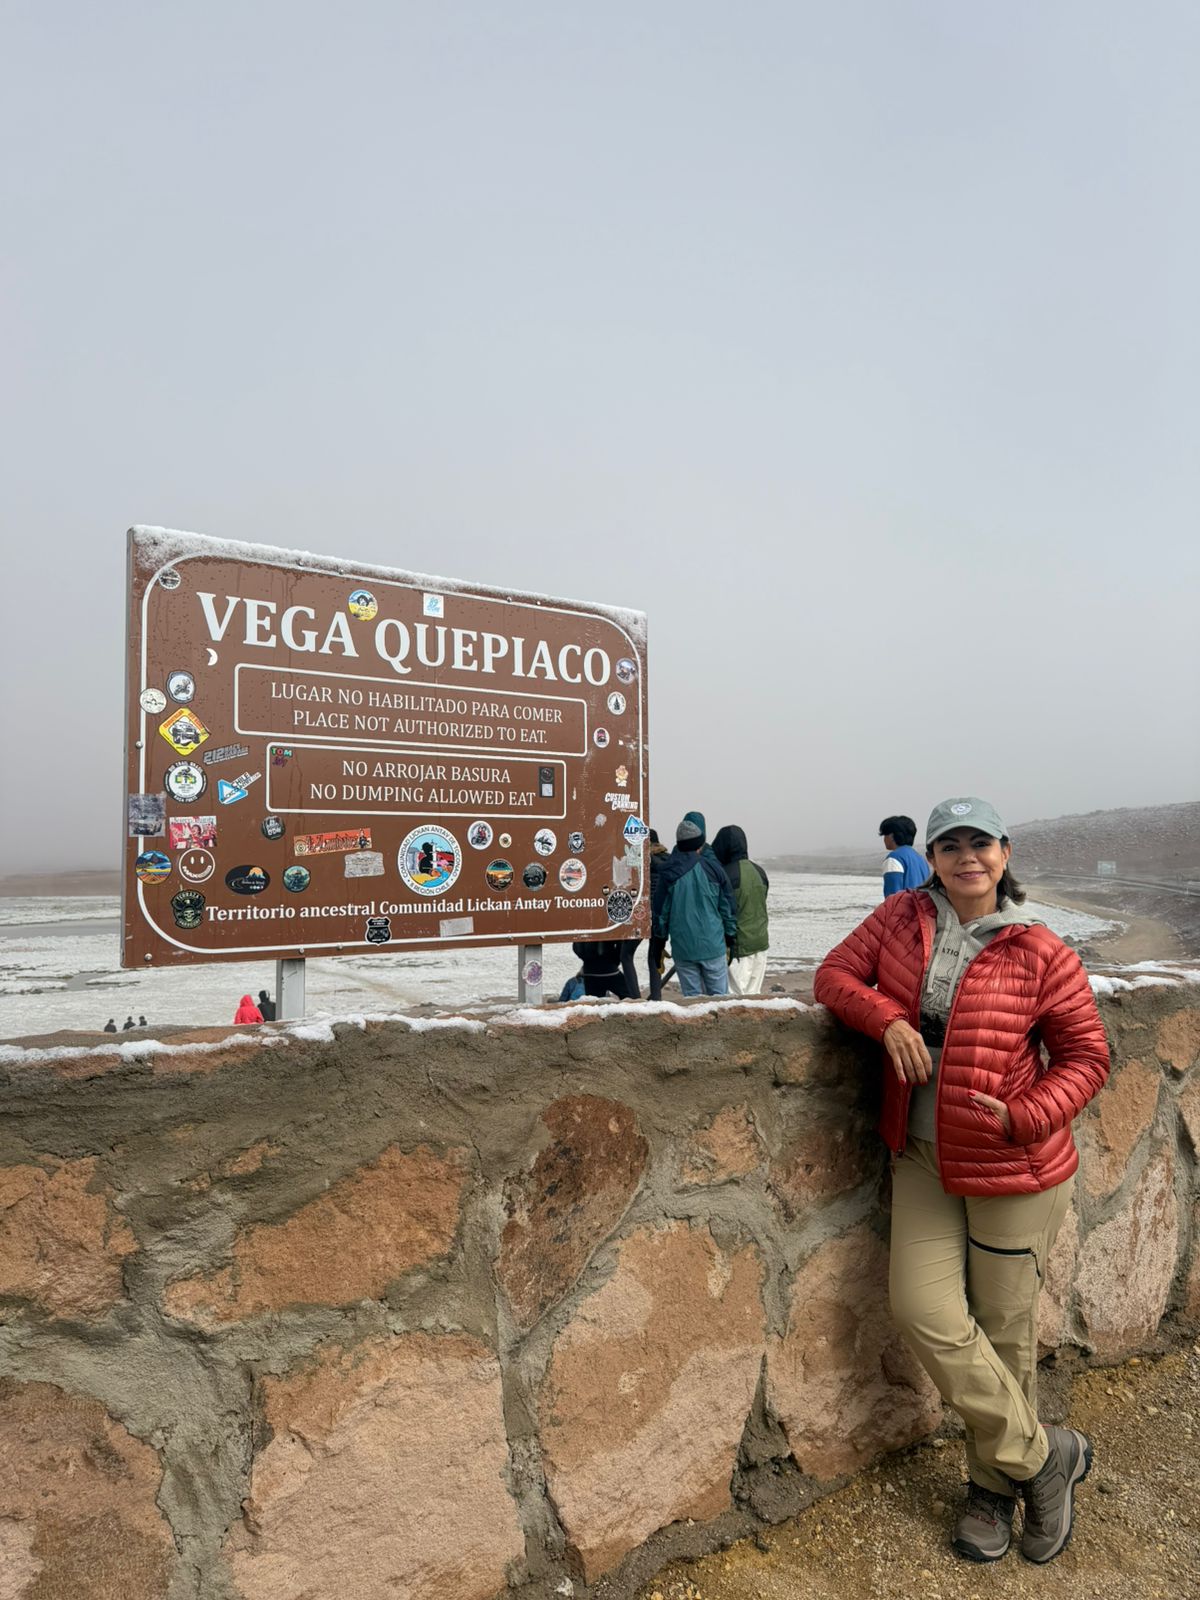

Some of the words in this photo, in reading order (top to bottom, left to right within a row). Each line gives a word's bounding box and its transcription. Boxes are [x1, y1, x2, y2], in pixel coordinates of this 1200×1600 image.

[196, 592, 359, 657] VEGA
[375, 619, 611, 686] QUEPIACO
[271, 682, 333, 703] LUGAR
[338, 688, 363, 706] NO
[368, 691, 468, 715] HABILITADO
[472, 701, 510, 718] PARA
[513, 705, 563, 723] COMER
[293, 709, 349, 729] PLACE
[354, 715, 390, 732] NOT
[394, 718, 494, 740] AUTHORIZED
[497, 726, 517, 741] TO
[520, 728, 548, 744] EAT.
[271, 747, 293, 757] TOM
[342, 760, 368, 777] NO
[372, 762, 447, 783] ARROJAR
[451, 766, 511, 783] BASURA
[310, 783, 337, 800] NO
[342, 784, 423, 803] DUMPING
[428, 788, 504, 805] ALLOWED
[509, 791, 536, 806] EAT
[431, 826, 450, 838] ANTAY
[624, 826, 648, 835] ALPES
[206, 904, 296, 921] Territorio
[300, 901, 375, 918] ancestral
[380, 899, 464, 914] Comunidad
[467, 898, 512, 912] Lickan
[514, 897, 552, 913] Antay
[554, 896, 605, 908] Toconao
